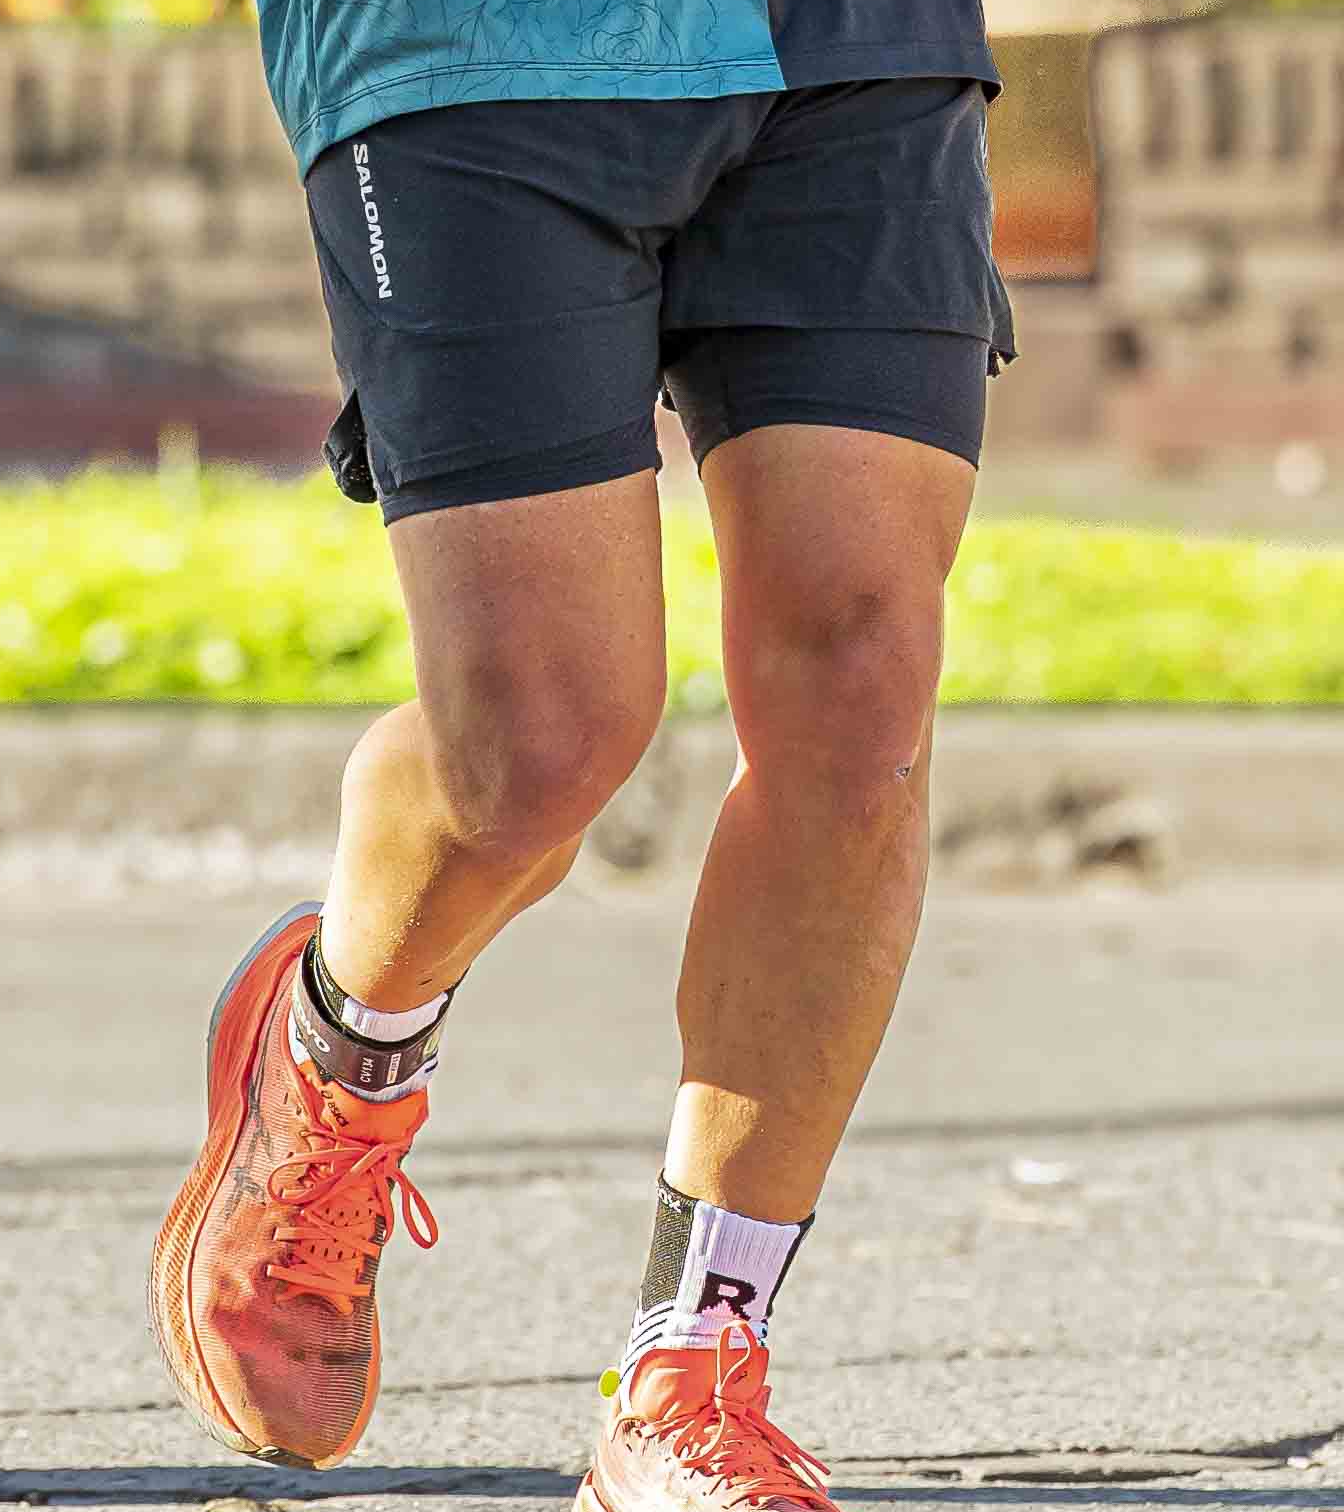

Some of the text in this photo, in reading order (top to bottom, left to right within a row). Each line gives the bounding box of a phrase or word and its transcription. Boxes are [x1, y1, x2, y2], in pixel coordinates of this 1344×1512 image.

[352, 143, 393, 299] SALOMON
[360, 1057, 374, 1083] CV134
[696, 1271, 758, 1322] R
